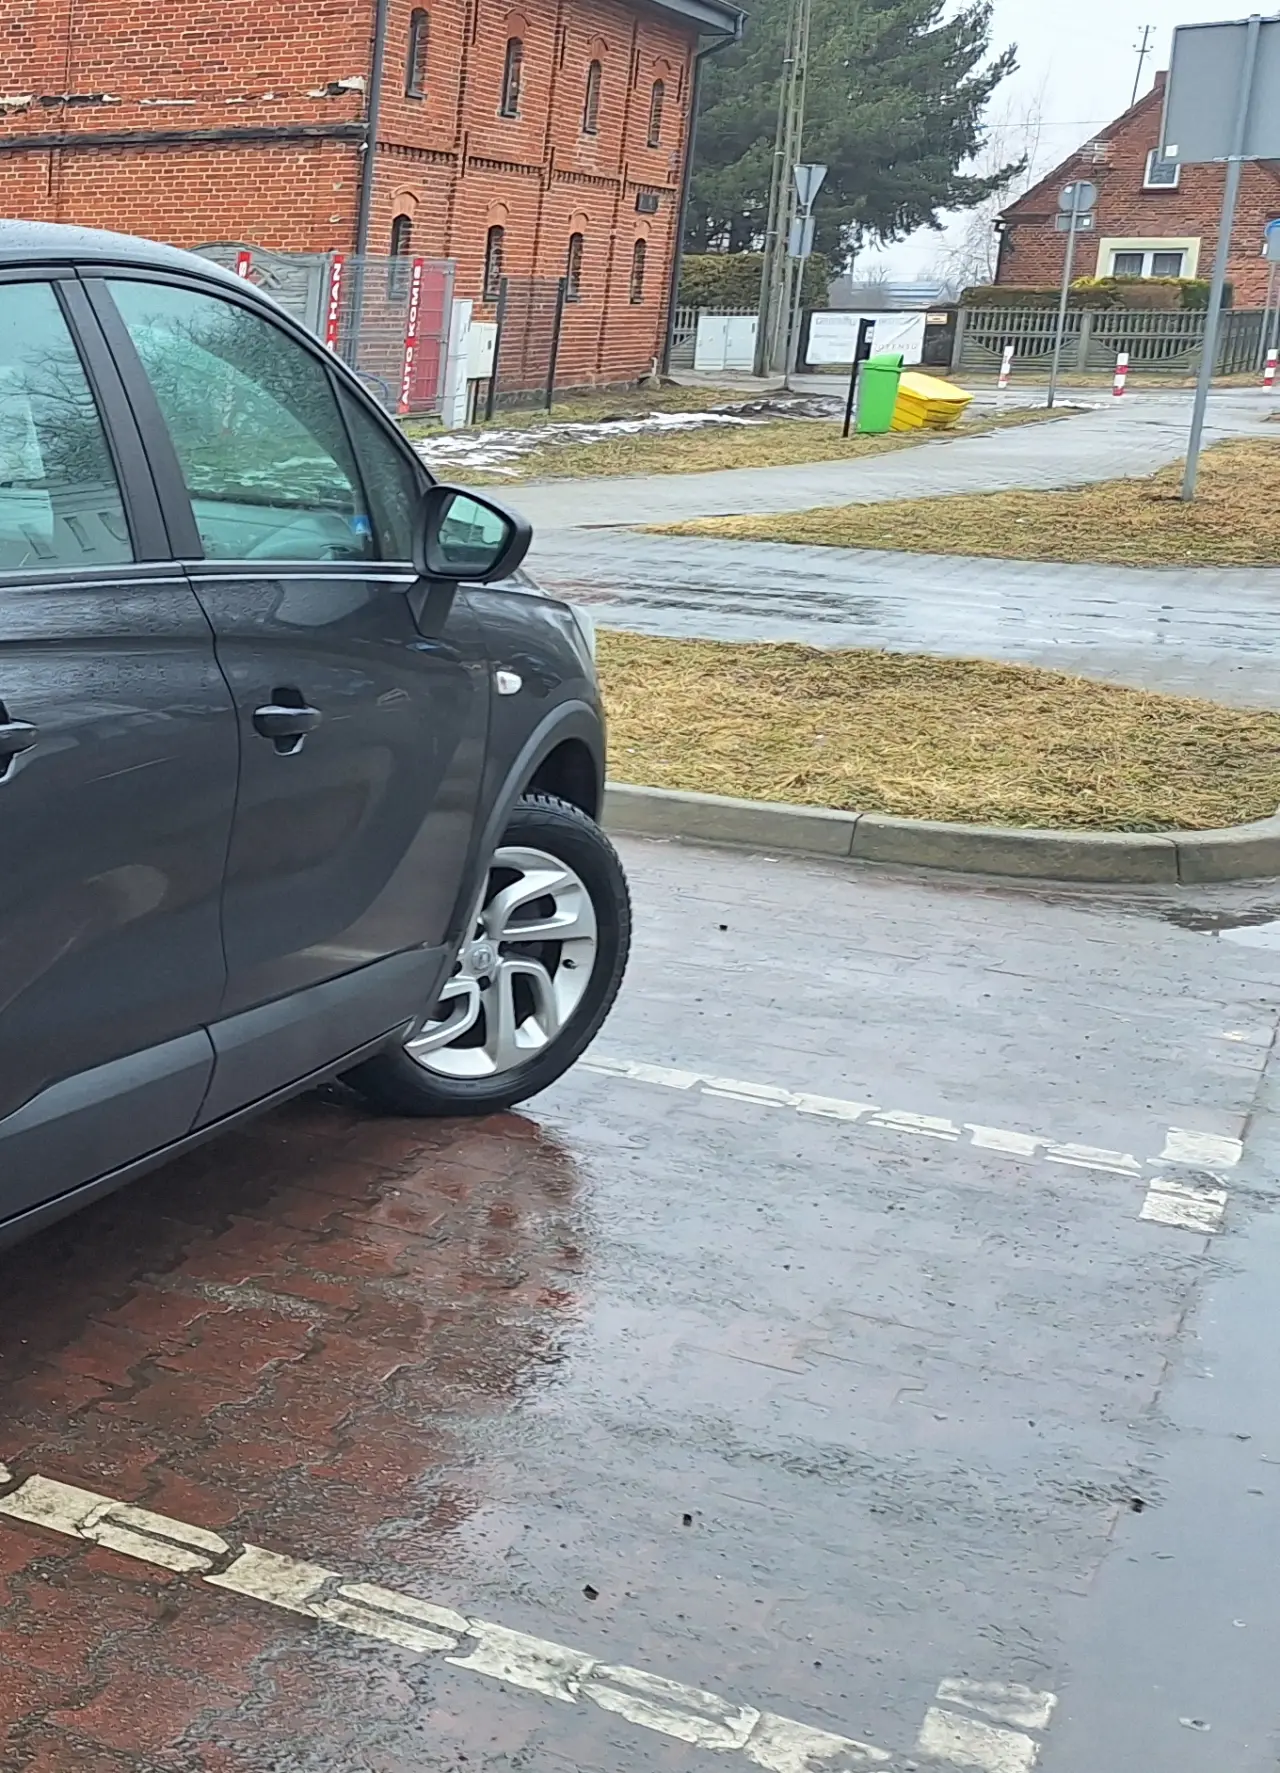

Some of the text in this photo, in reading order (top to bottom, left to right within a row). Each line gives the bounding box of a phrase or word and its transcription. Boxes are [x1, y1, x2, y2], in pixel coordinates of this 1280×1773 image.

[329, 263, 341, 320] HAN
[402, 266, 421, 404] AUTO KOMIS
